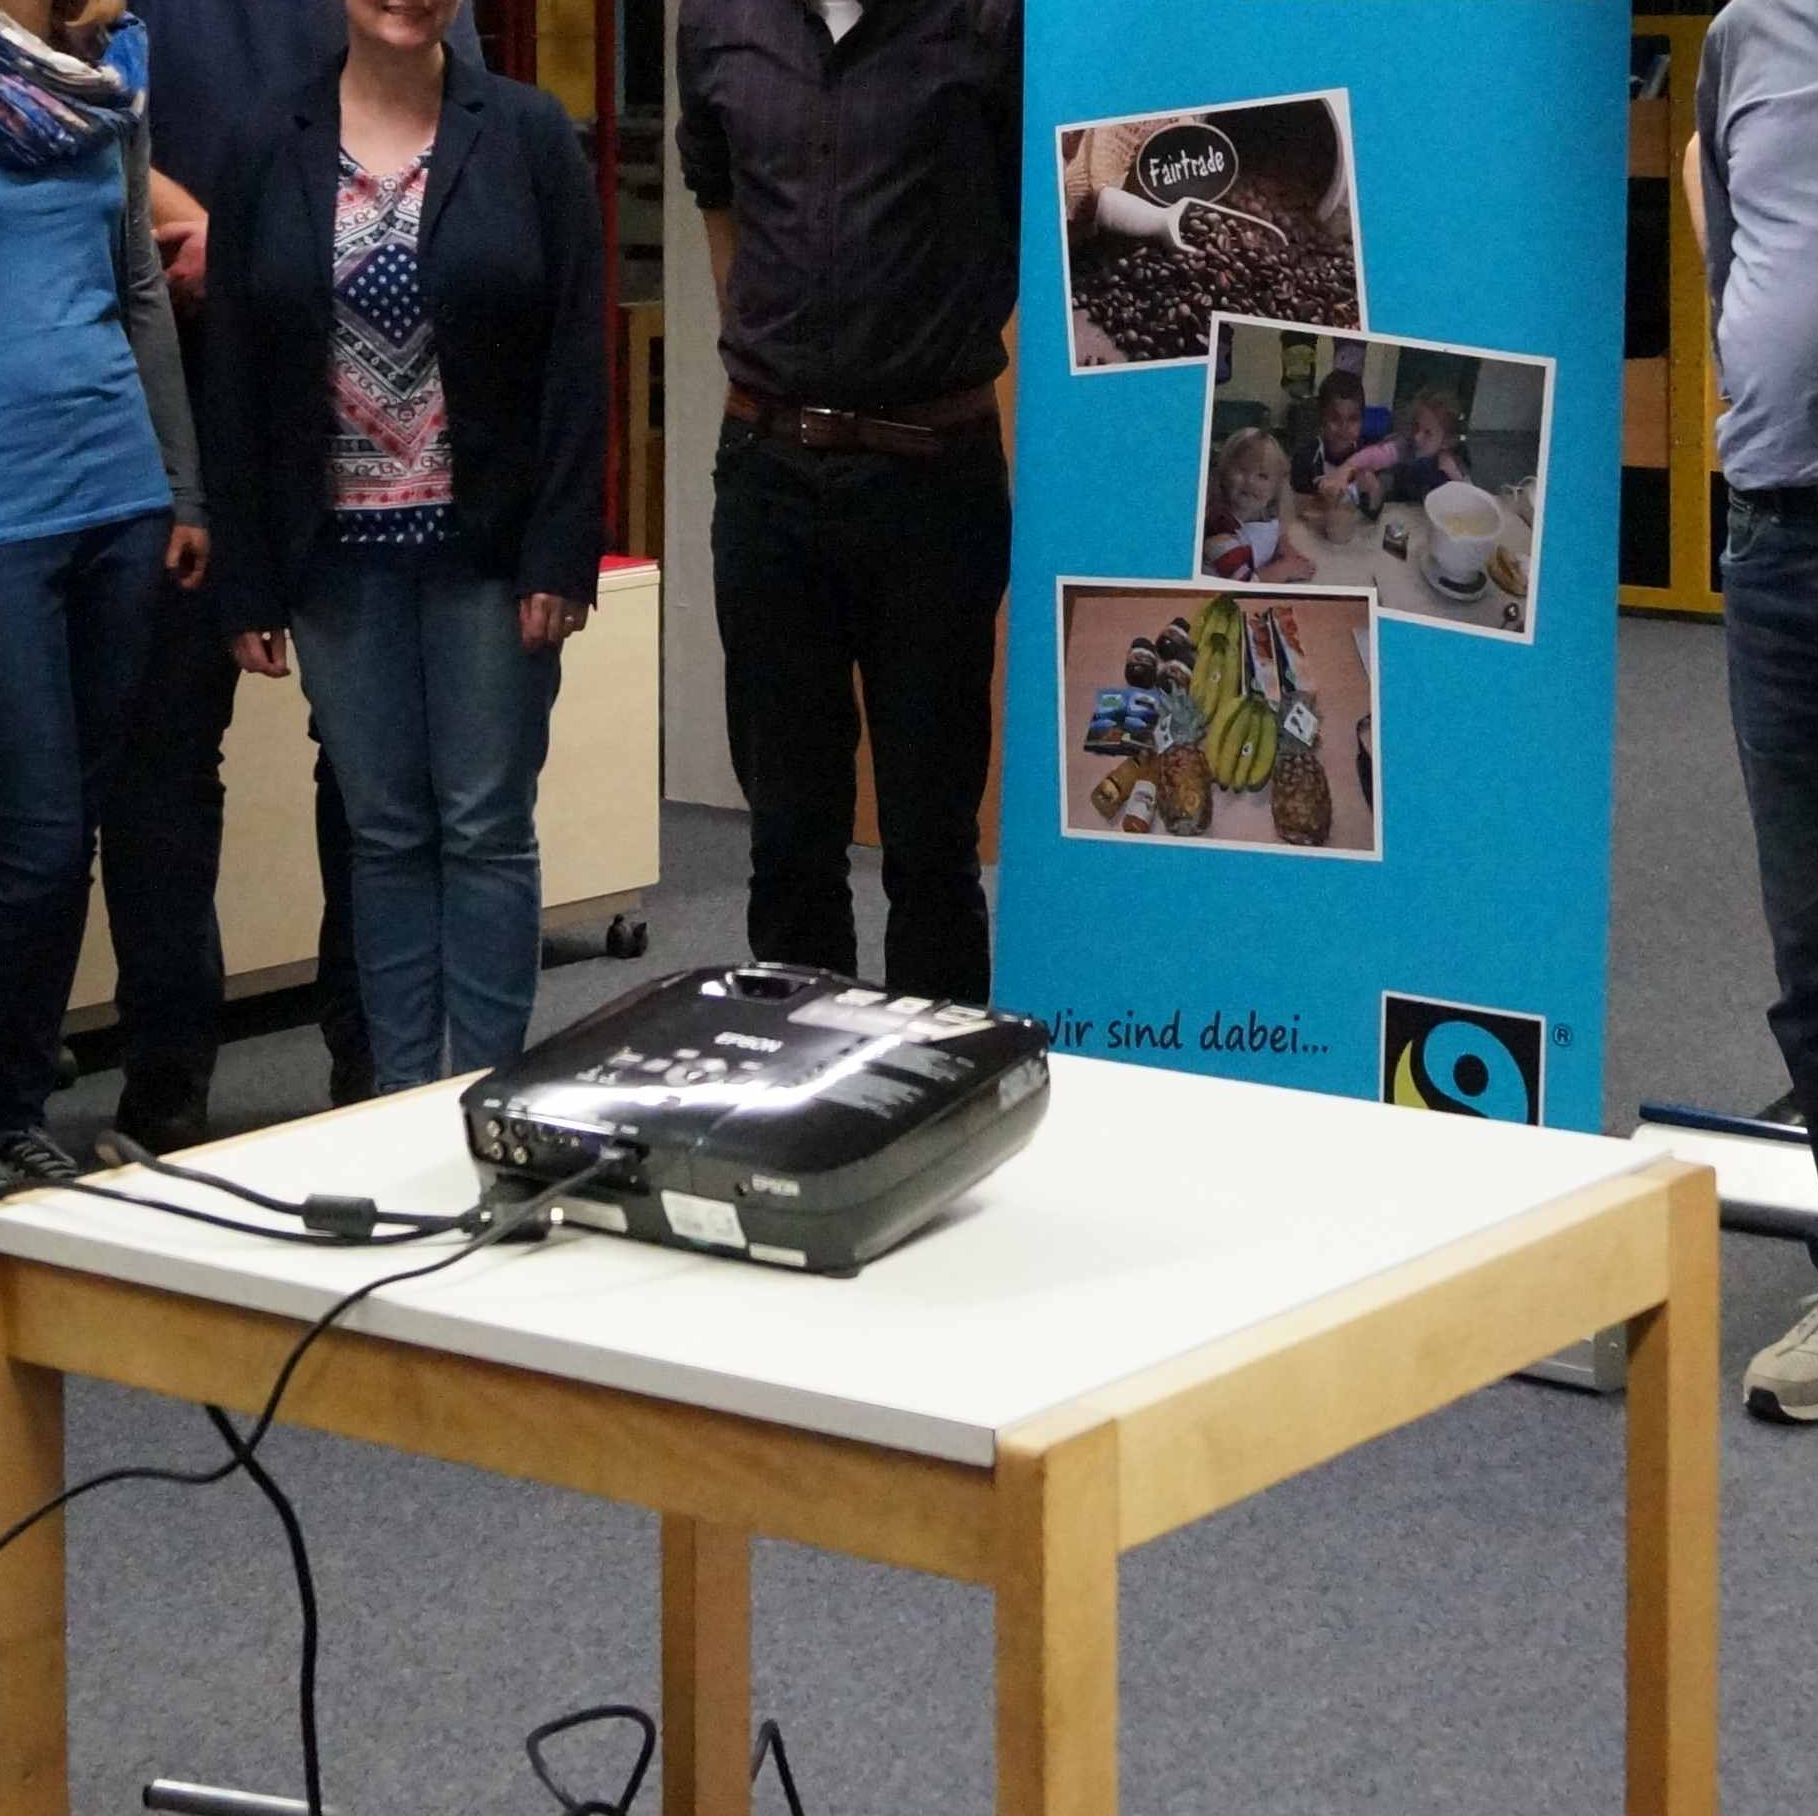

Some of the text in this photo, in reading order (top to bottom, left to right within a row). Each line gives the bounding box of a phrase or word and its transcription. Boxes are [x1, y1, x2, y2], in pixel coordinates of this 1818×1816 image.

[1148, 145, 1225, 187] Fairtrade
[1107, 1009, 1184, 1052] sind
[1199, 1010, 1329, 1055] dabei...
